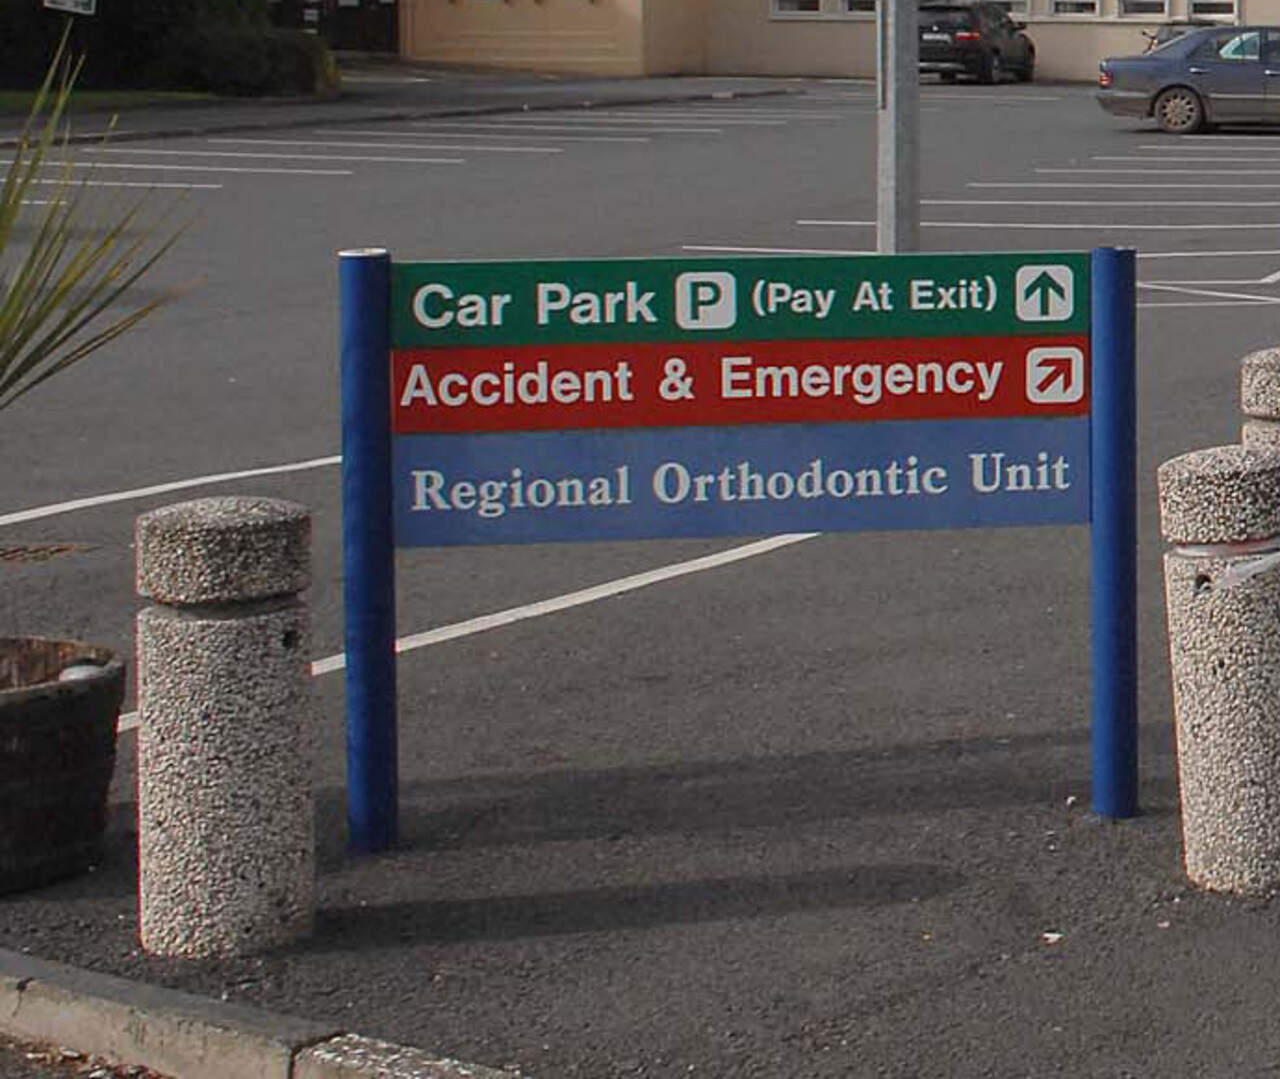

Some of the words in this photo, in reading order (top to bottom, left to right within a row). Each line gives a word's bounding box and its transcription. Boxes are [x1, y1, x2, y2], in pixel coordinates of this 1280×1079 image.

[413, 282, 512, 330] Car
[536, 280, 659, 326] Park
[752, 279, 836, 319] (Pay
[852, 281, 894, 311] At
[910, 275, 997, 311] Exit)
[400, 361, 634, 408] Accident
[658, 357, 696, 402] &
[720, 357, 1004, 405] Emergency
[410, 466, 632, 519] Regional
[652, 460, 948, 505] Orthodontic
[970, 452, 1071, 493] Unit
